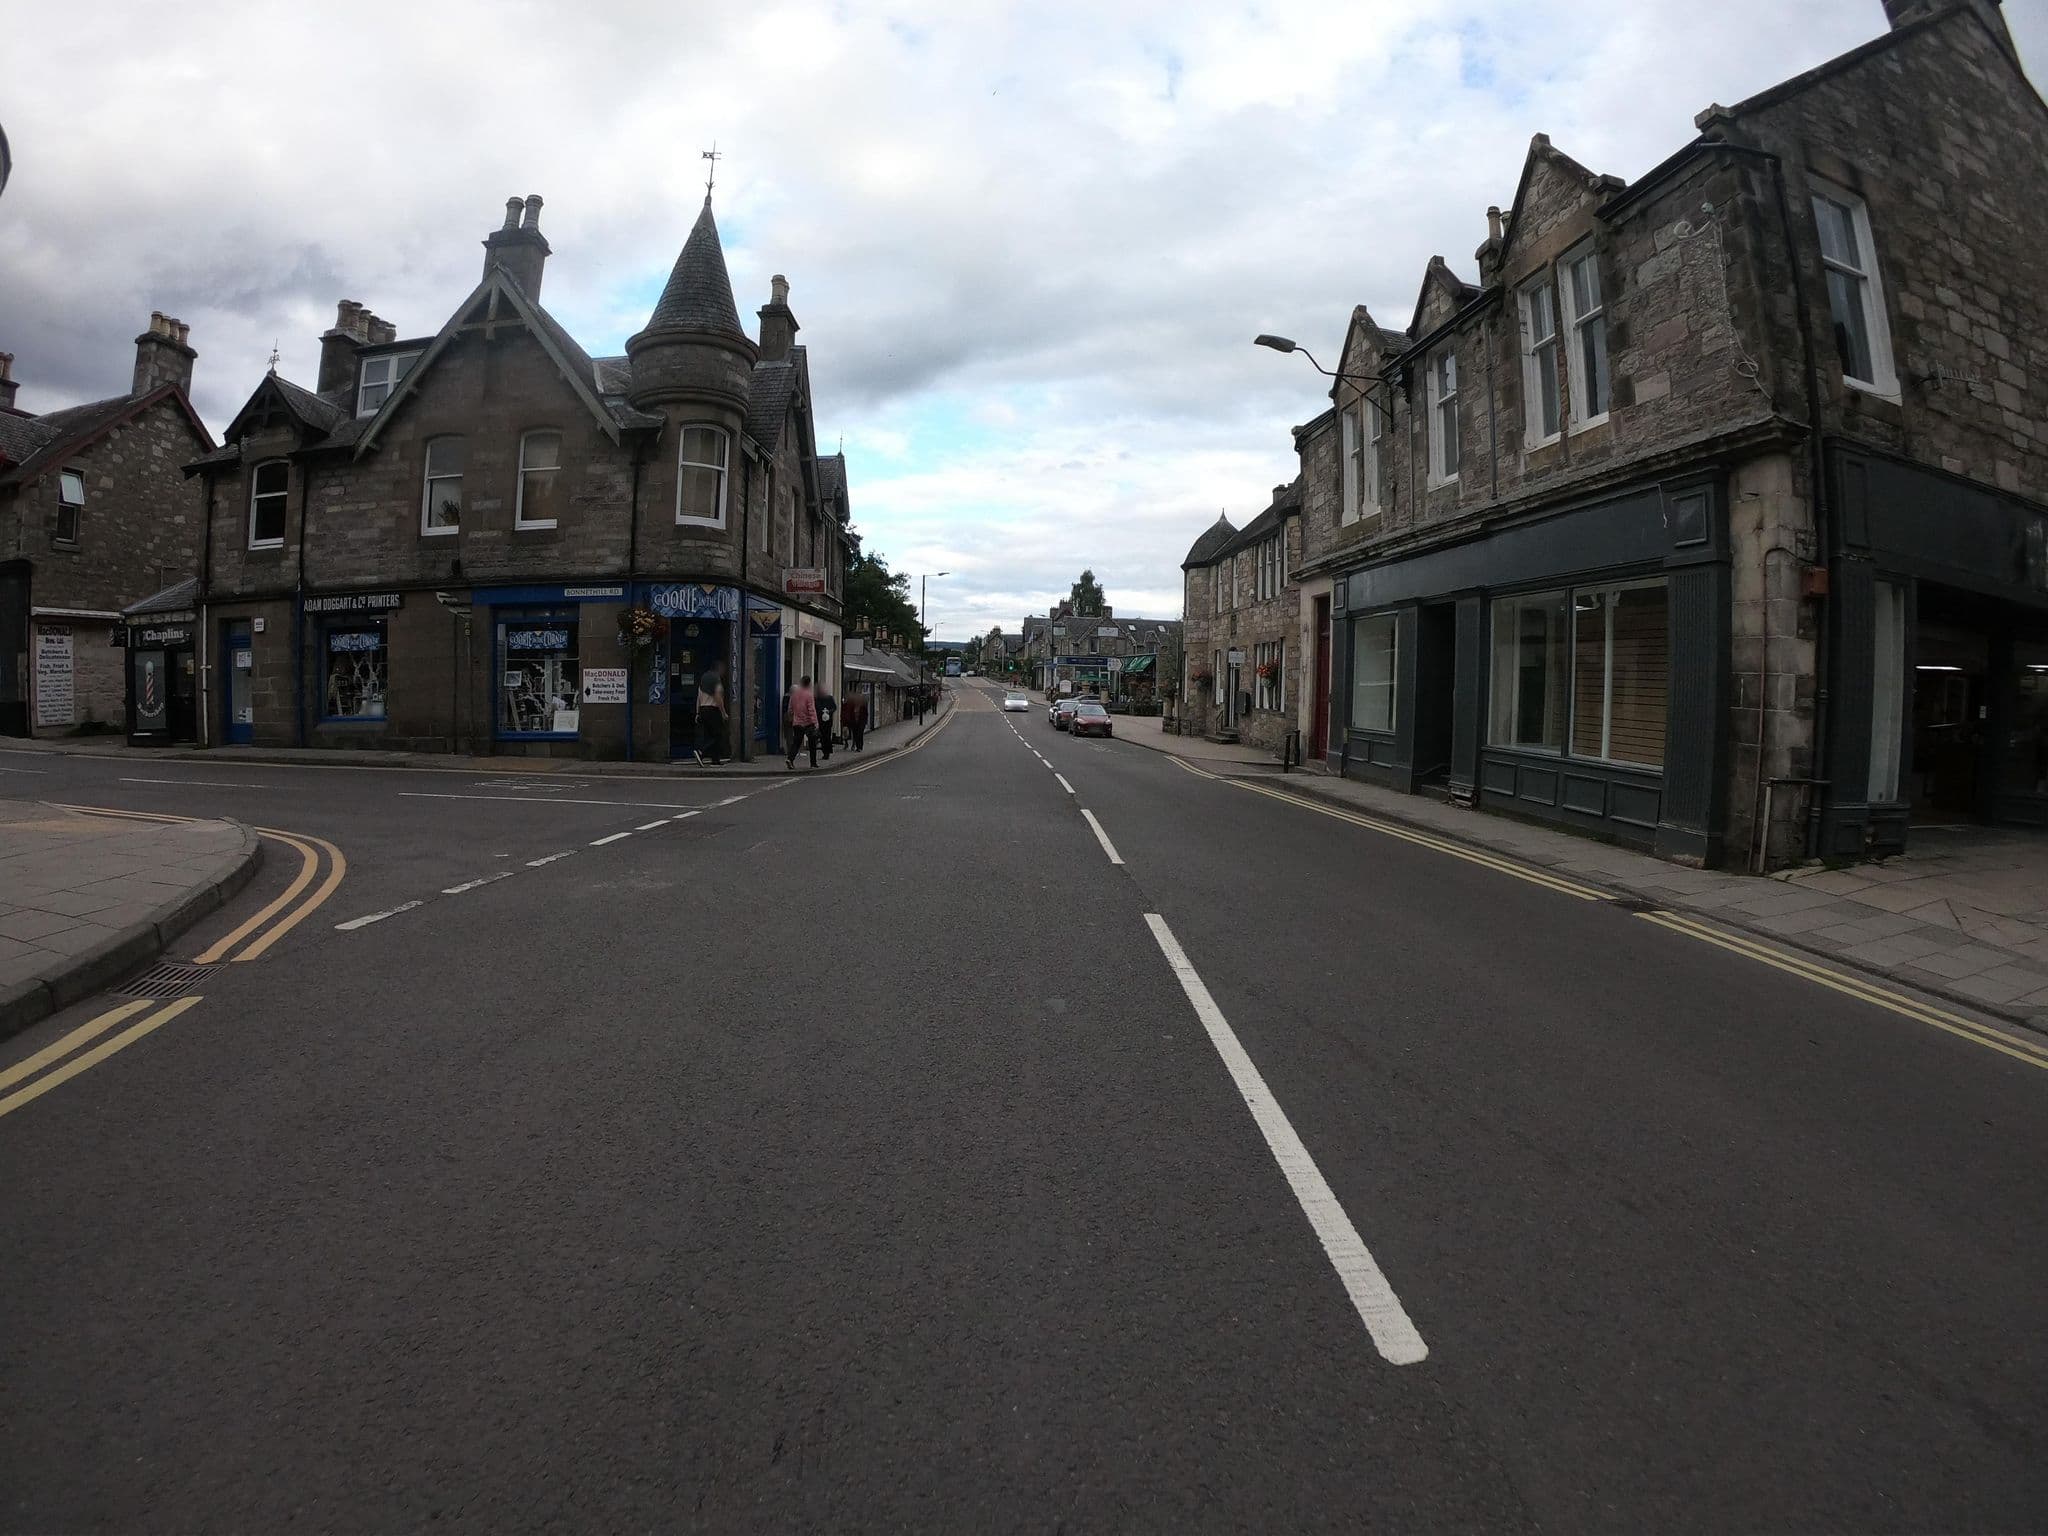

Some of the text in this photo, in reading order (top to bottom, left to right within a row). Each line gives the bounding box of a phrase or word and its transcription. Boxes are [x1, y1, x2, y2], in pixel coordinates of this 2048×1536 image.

[304, 599, 322, 612] ADAM
[323, 597, 352, 611] DOGGART
[352, 598, 358, 609] &
[368, 594, 400, 608] PRINTERS
[655, 587, 697, 613] COORIE
[706, 595, 717, 607] THE
[145, 628, 184, 643] Chaplins
